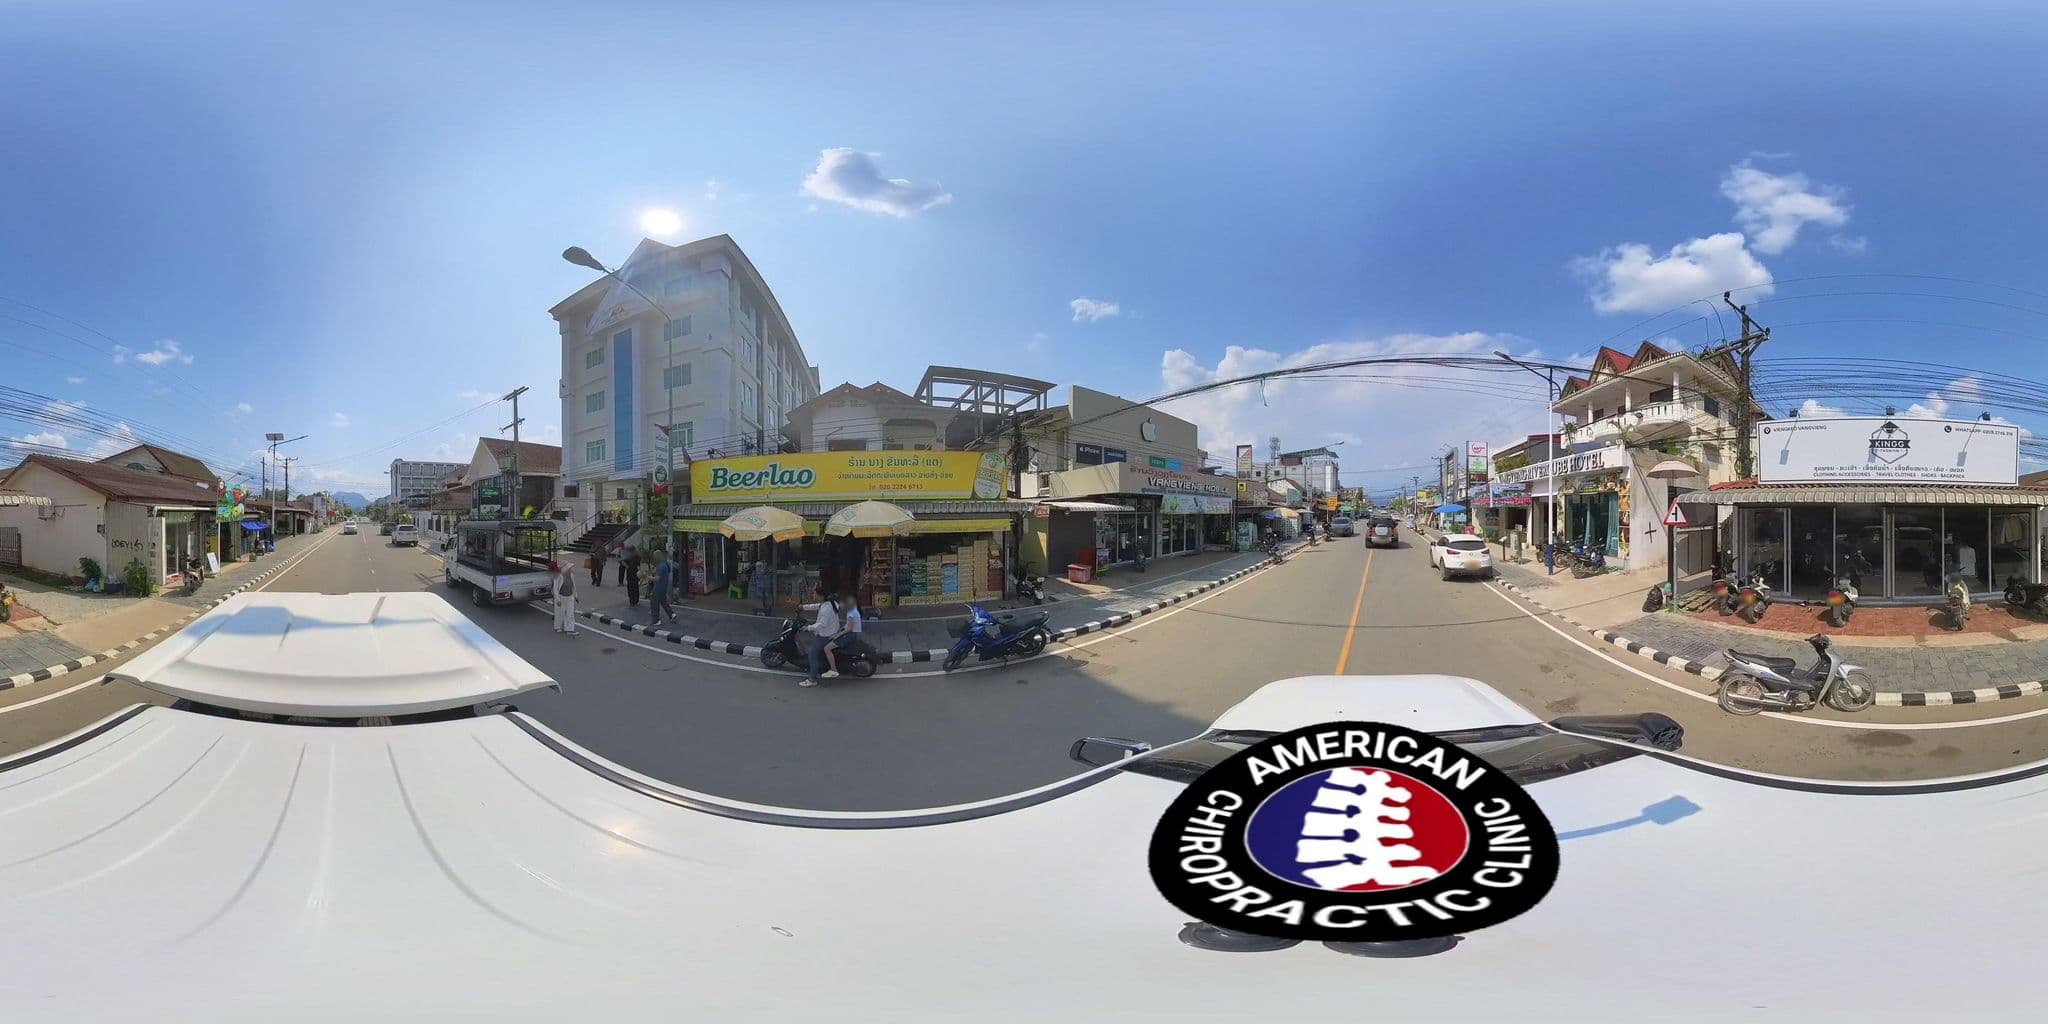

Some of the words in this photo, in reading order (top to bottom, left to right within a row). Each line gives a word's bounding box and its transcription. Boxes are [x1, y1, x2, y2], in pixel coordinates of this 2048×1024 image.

[1569, 452, 1605, 473] HOTEL
[710, 463, 814, 490] Beerlao
[1149, 477, 1203, 490] VANGVIENG
